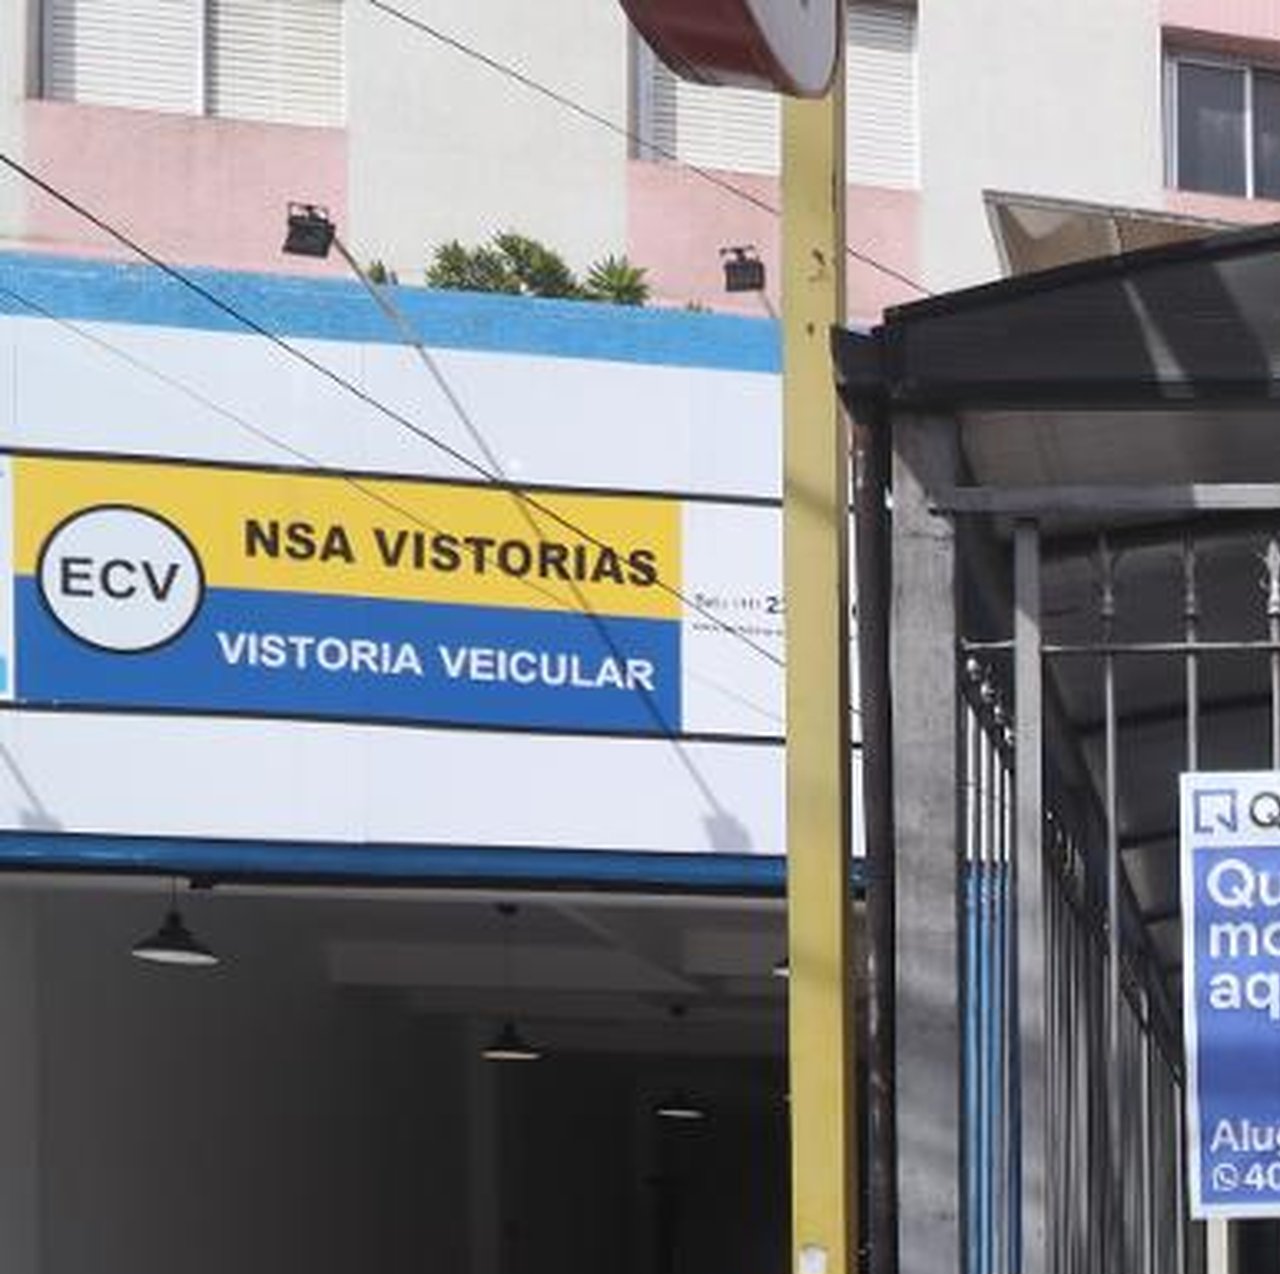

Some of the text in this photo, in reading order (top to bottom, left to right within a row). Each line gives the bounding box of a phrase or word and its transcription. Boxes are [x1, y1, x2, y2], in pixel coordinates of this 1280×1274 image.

[59, 555, 181, 602] ECV
[244, 519, 659, 588] NSA VISTORIAS
[217, 631, 656, 692] VISTORIA VEICULAR
